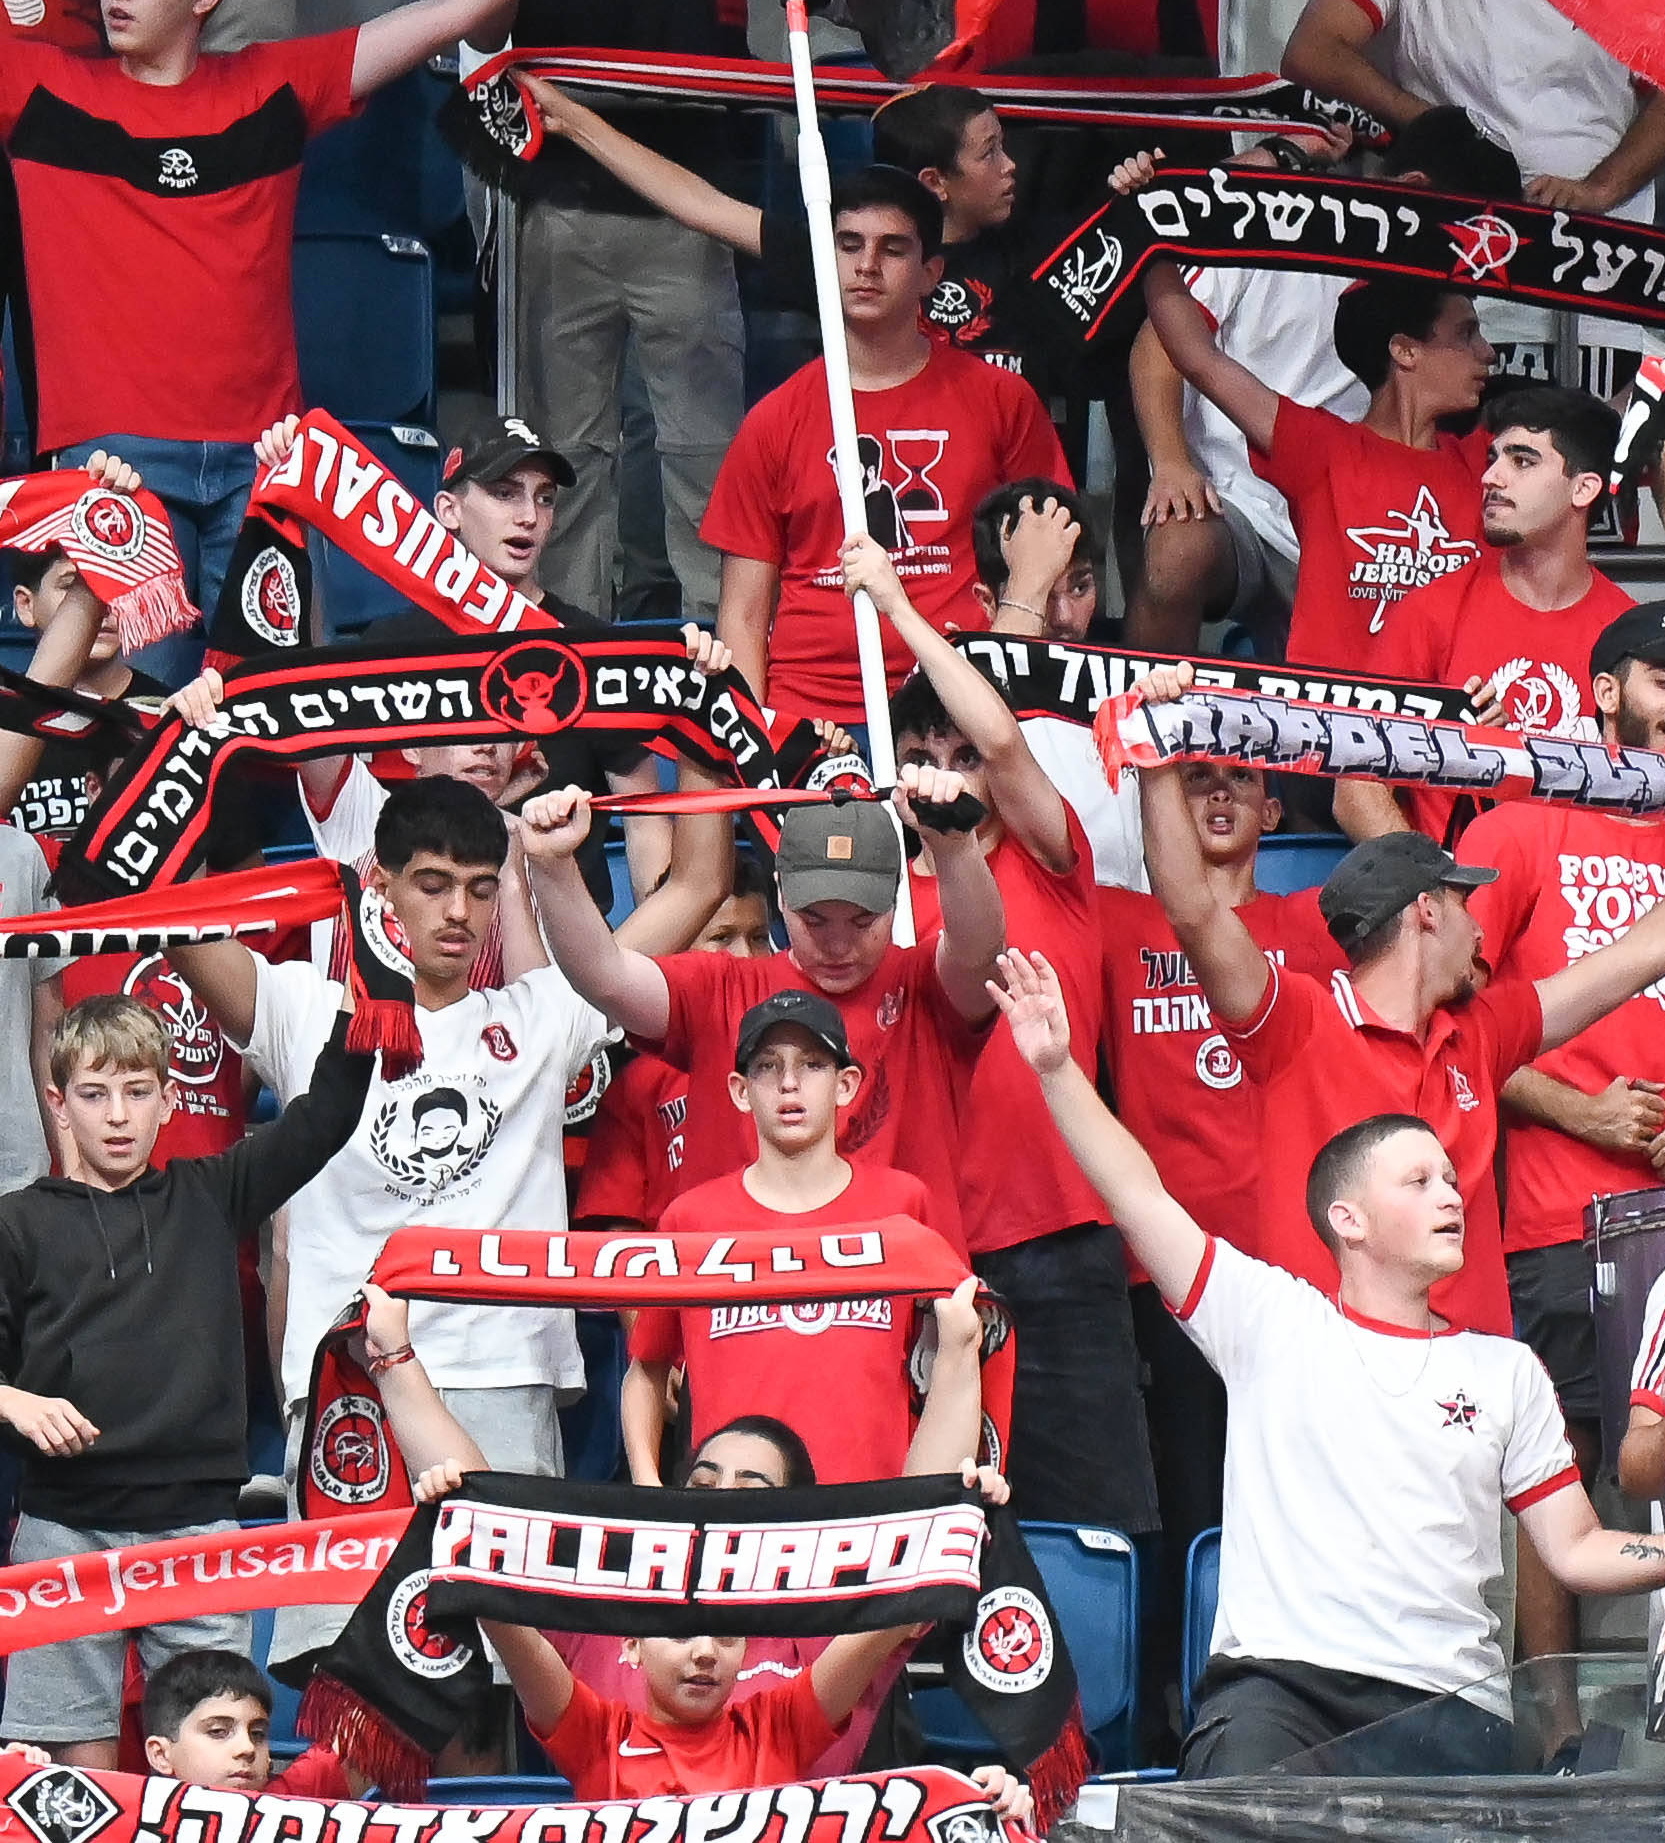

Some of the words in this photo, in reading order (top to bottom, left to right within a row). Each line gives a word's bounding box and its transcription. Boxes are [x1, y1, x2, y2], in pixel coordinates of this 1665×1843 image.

[1137, 167, 1420, 254] ירושלים
[258, 427, 543, 634] JERUSALE
[1347, 586, 1377, 600] LOVE
[1349, 562, 1444, 587] JERUS
[293, 674, 473, 730] השדים
[1132, 997, 1213, 1035] אהבה
[431, 1228, 887, 1285] ירושלים
[835, 1297, 893, 1328] 1943
[431, 1505, 697, 1592] YALLA
